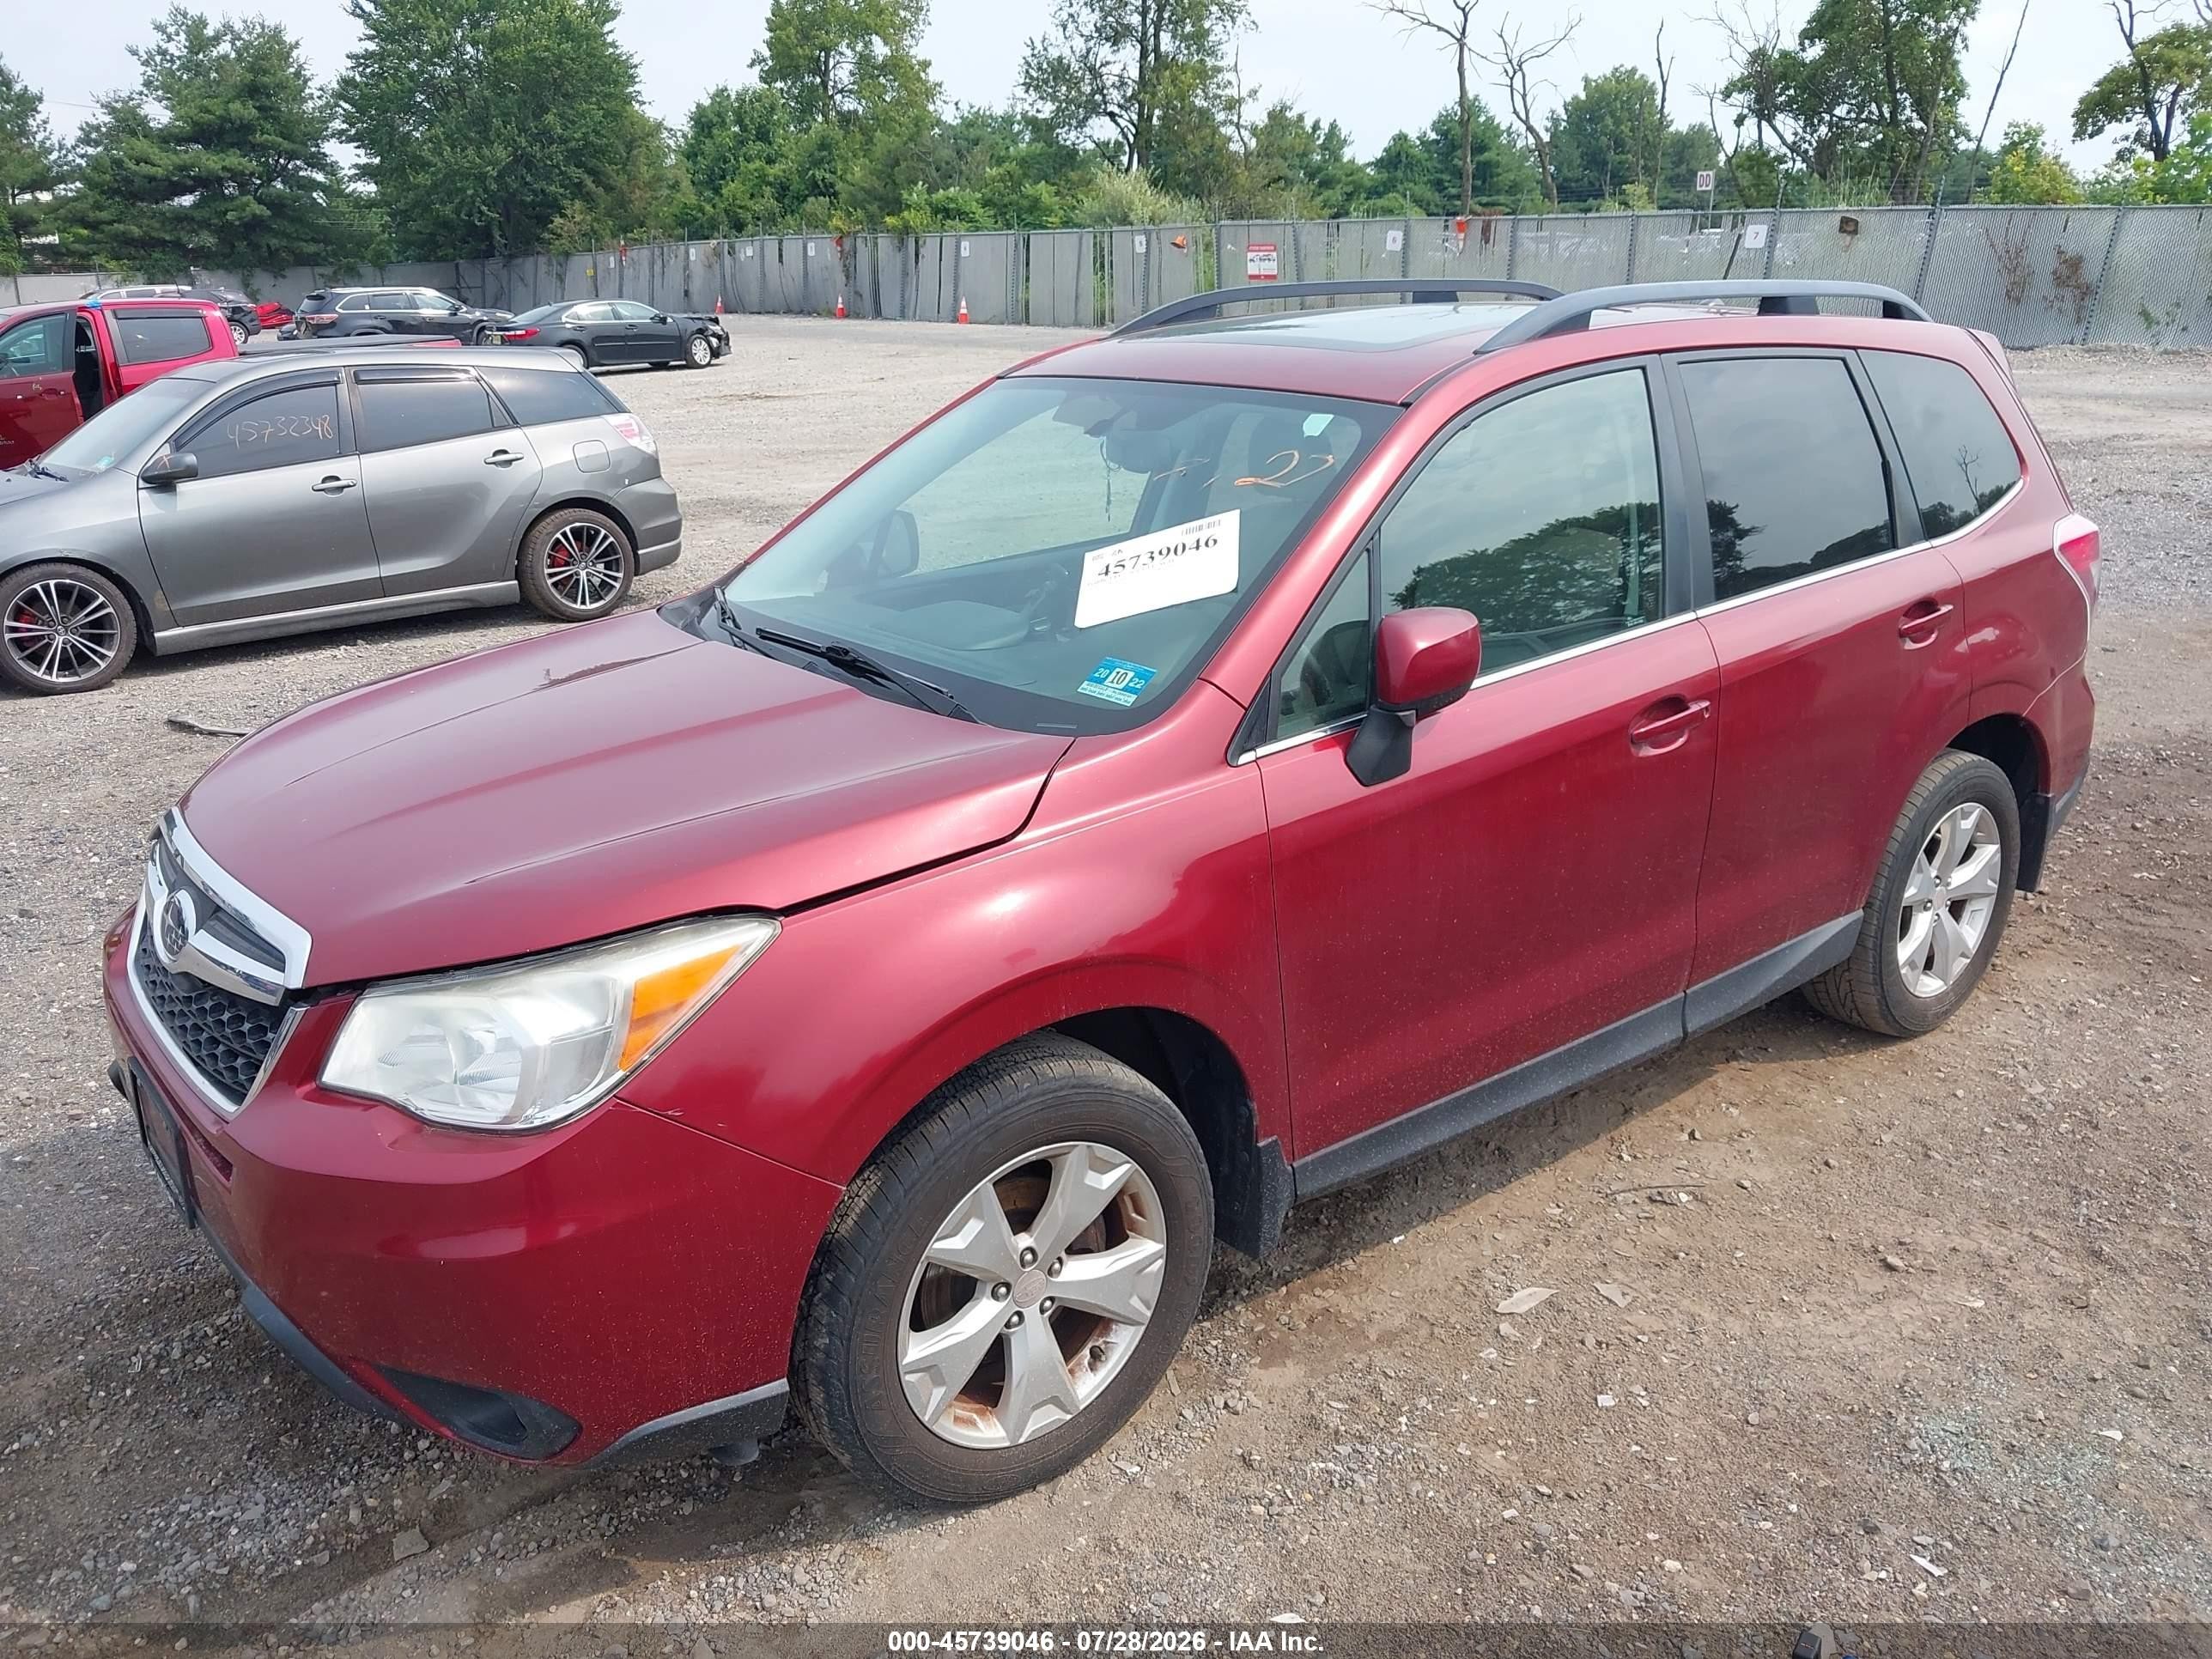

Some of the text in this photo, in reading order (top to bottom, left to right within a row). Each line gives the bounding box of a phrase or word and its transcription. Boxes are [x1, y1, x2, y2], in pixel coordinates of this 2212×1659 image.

[1753, 231, 1759, 240] 7
[227, 415, 334, 449] 45732348
[1097, 533, 1218, 577] 45739046
[1093, 667, 1146, 689] 20 10 22
